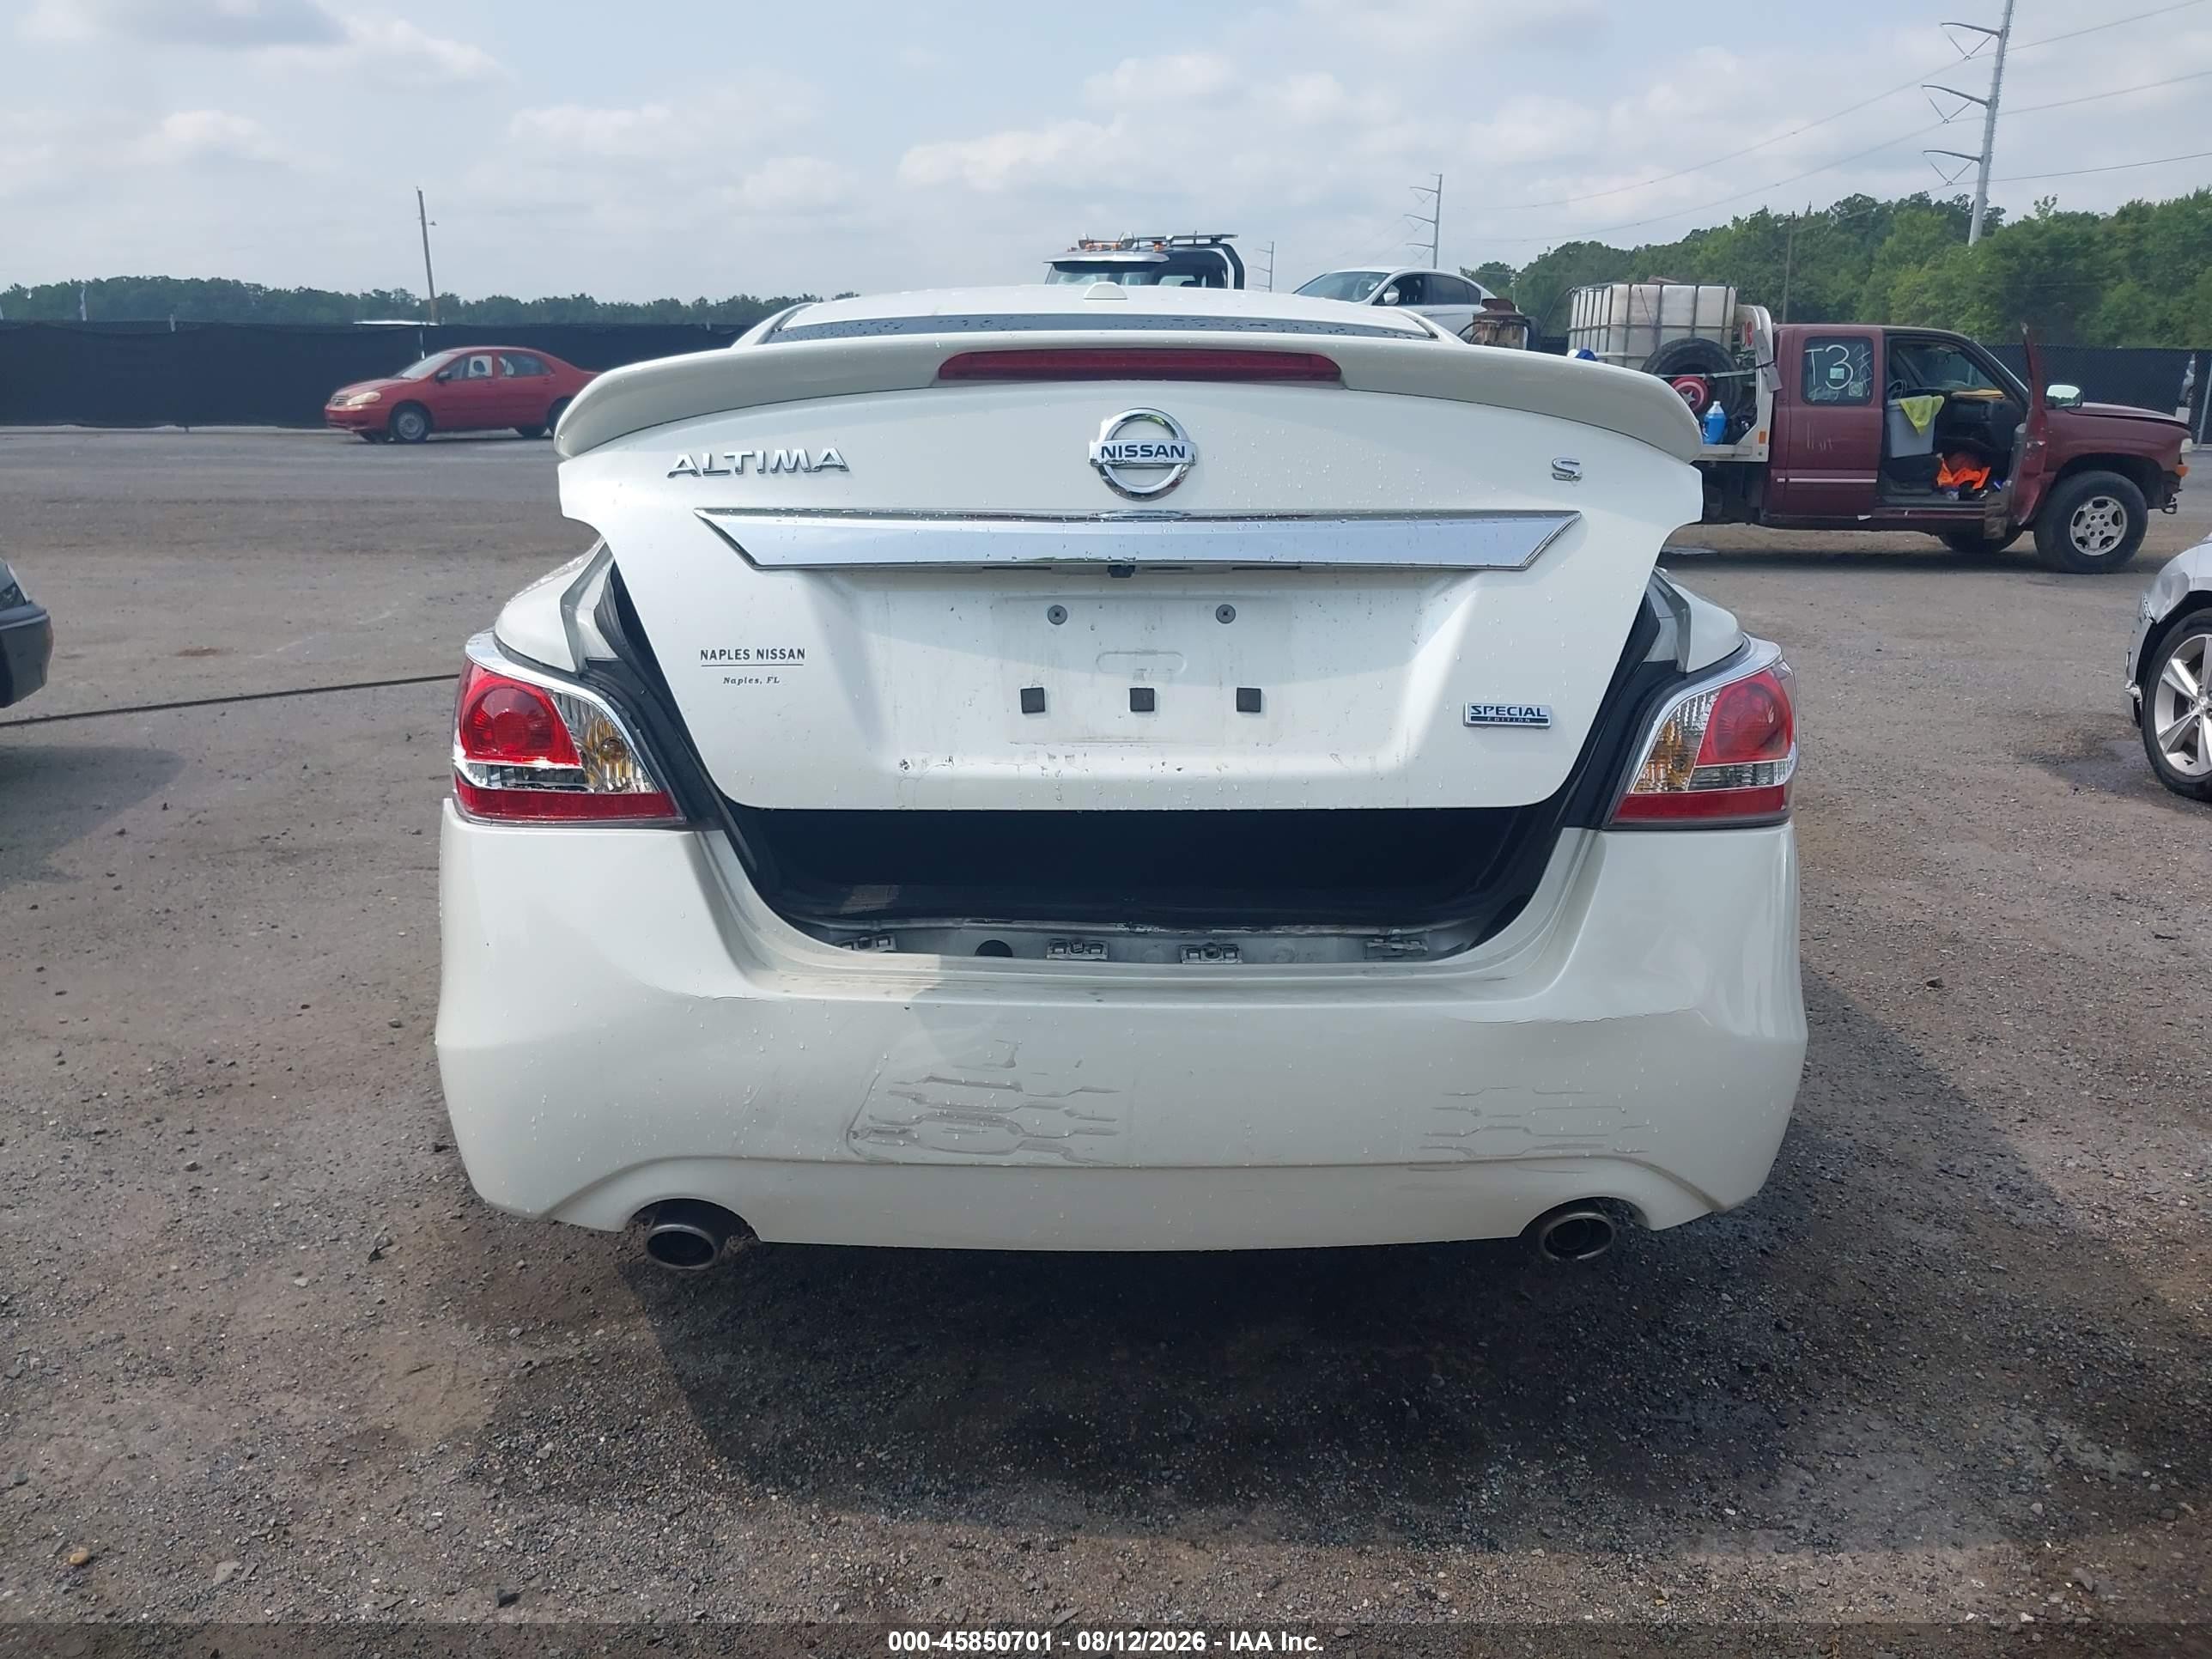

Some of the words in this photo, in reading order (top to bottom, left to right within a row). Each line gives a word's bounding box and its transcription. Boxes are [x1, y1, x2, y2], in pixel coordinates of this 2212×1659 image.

[1101, 444, 1186, 459] NISSAN
[666, 447, 850, 479] ALTIMA
[1552, 457, 1582, 482] S
[700, 648, 750, 660] NAPLES
[757, 647, 805, 660] NISSAN
[722, 676, 763, 686] Naples,
[766, 676, 780, 684] FL
[1470, 705, 1548, 718] SPECIAL
